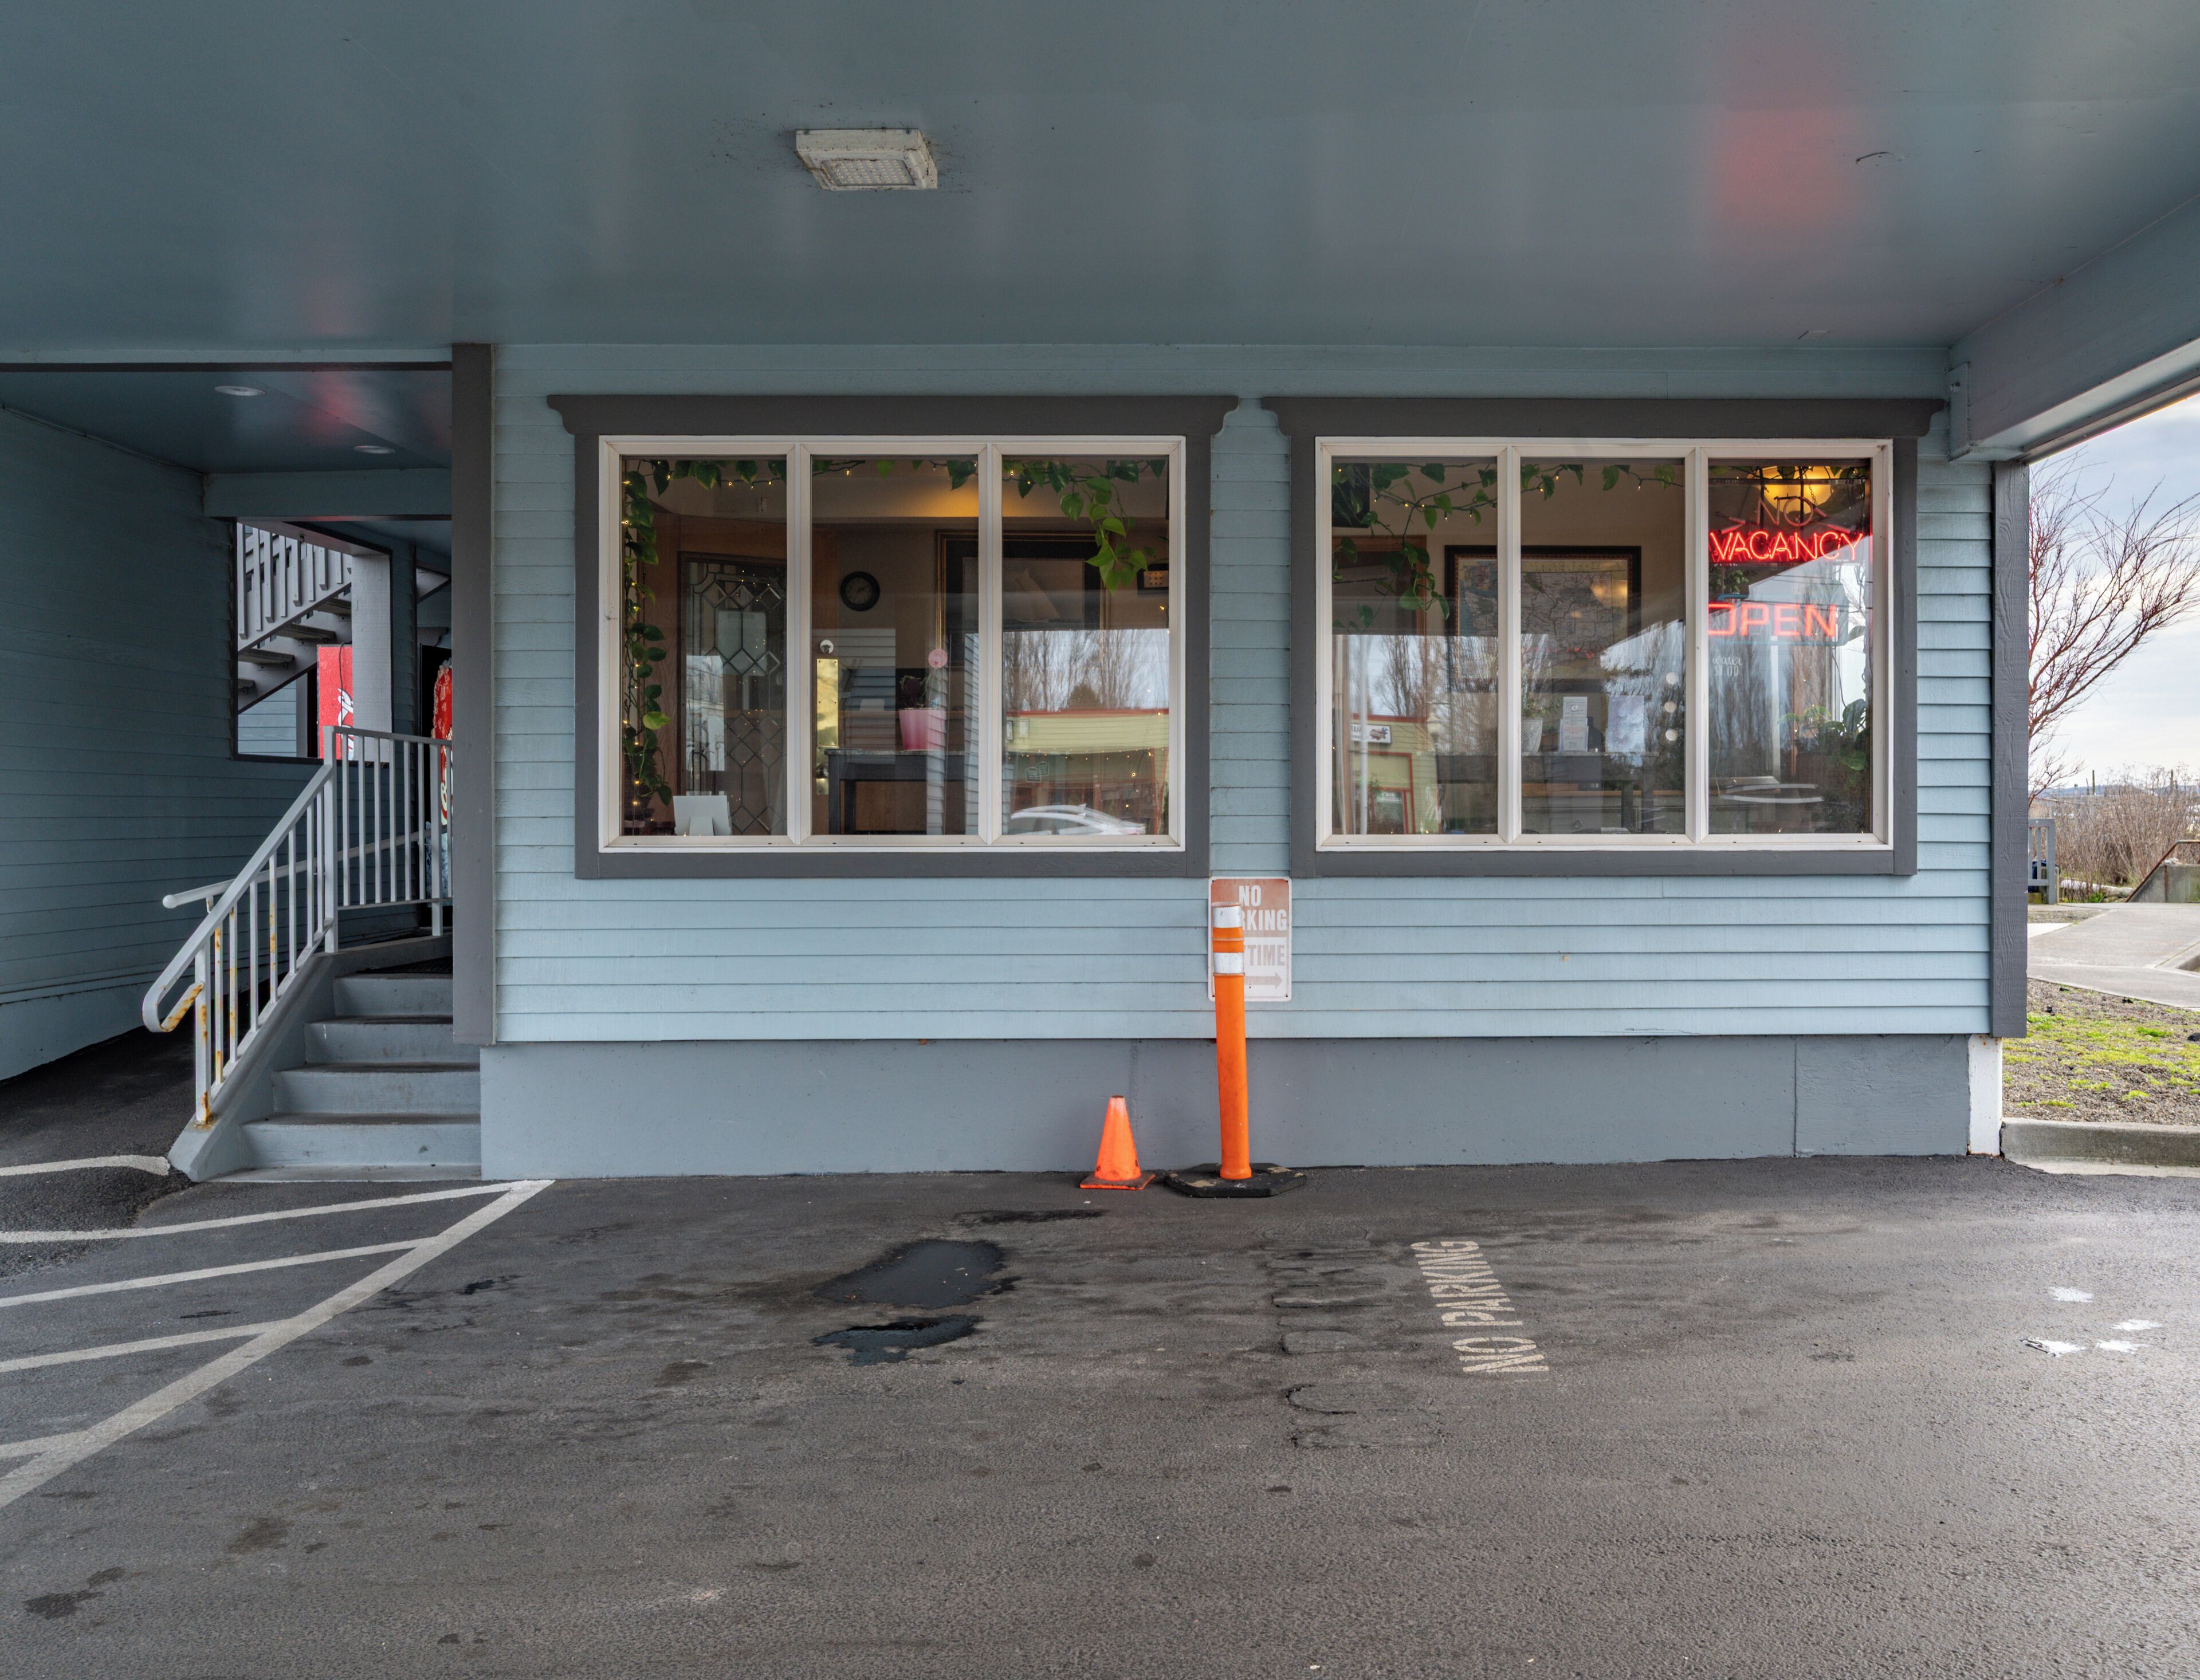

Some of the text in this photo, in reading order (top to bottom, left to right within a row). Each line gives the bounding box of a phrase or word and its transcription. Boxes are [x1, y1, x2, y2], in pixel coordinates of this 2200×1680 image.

[1756, 496, 1813, 526] NO
[1709, 530, 1865, 561] VACANCY
[1708, 603, 1837, 636] OPEN
[1239, 885, 1261, 907] NO
[1242, 909, 1287, 931] KING
[1244, 945, 1285, 966] TIME
[1410, 1241, 1549, 1372] NO PARKING
